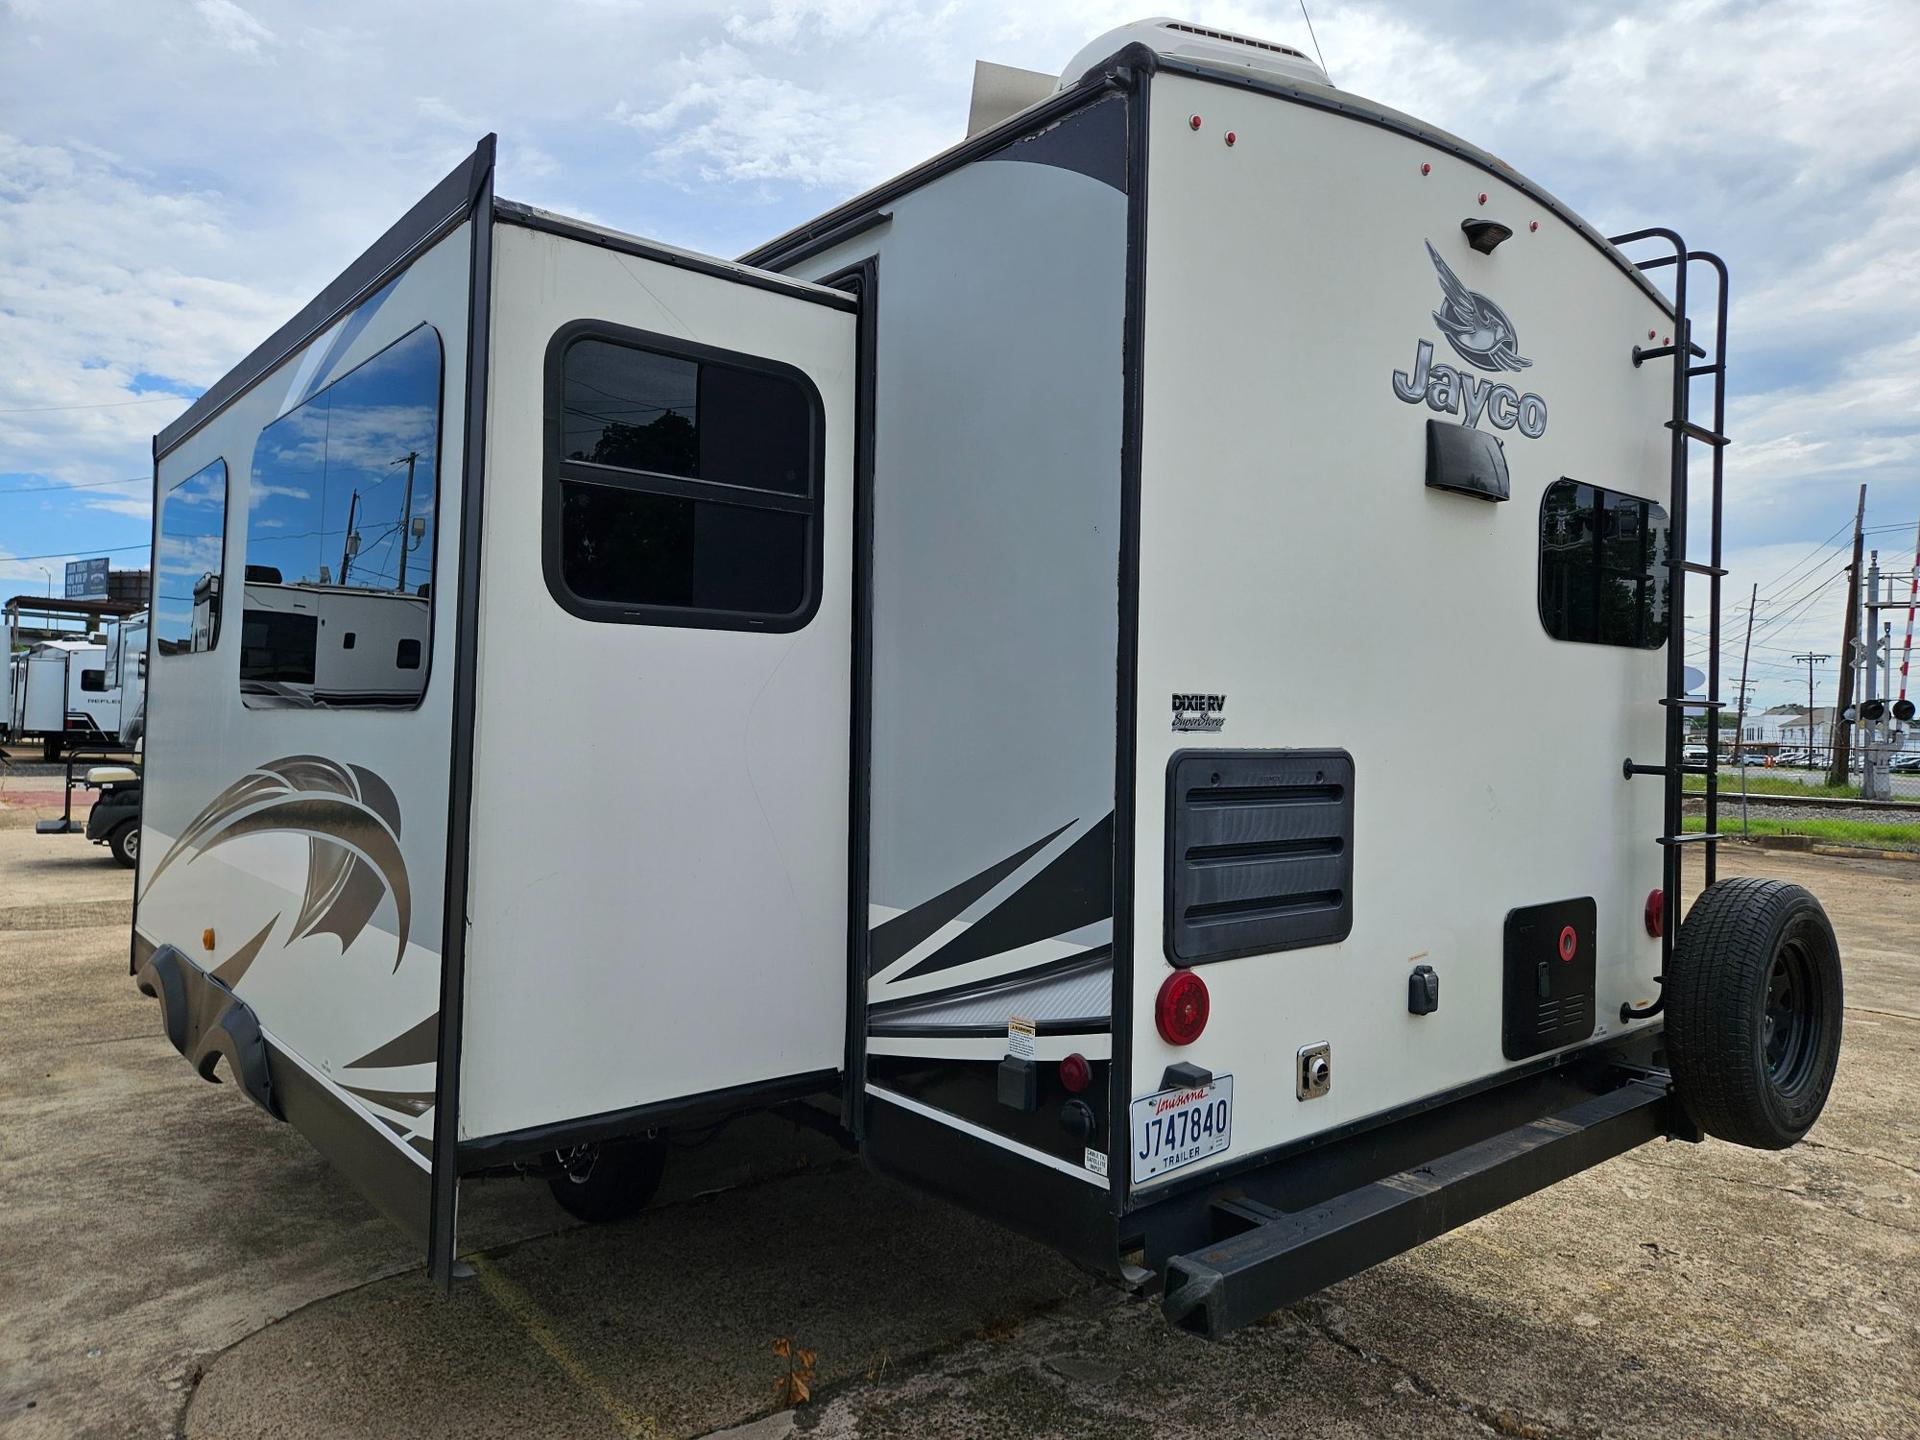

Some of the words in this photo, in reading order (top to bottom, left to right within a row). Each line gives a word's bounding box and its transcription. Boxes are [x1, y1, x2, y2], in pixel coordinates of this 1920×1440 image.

[1392, 338, 1548, 439] Jayco
[1172, 694, 1206, 711] DIXIE
[1207, 694, 1226, 711] RV
[1156, 1088, 1208, 1115] Louisiana
[1139, 1099, 1227, 1160] J747840
[1163, 1146, 1200, 1168] TRAILER
